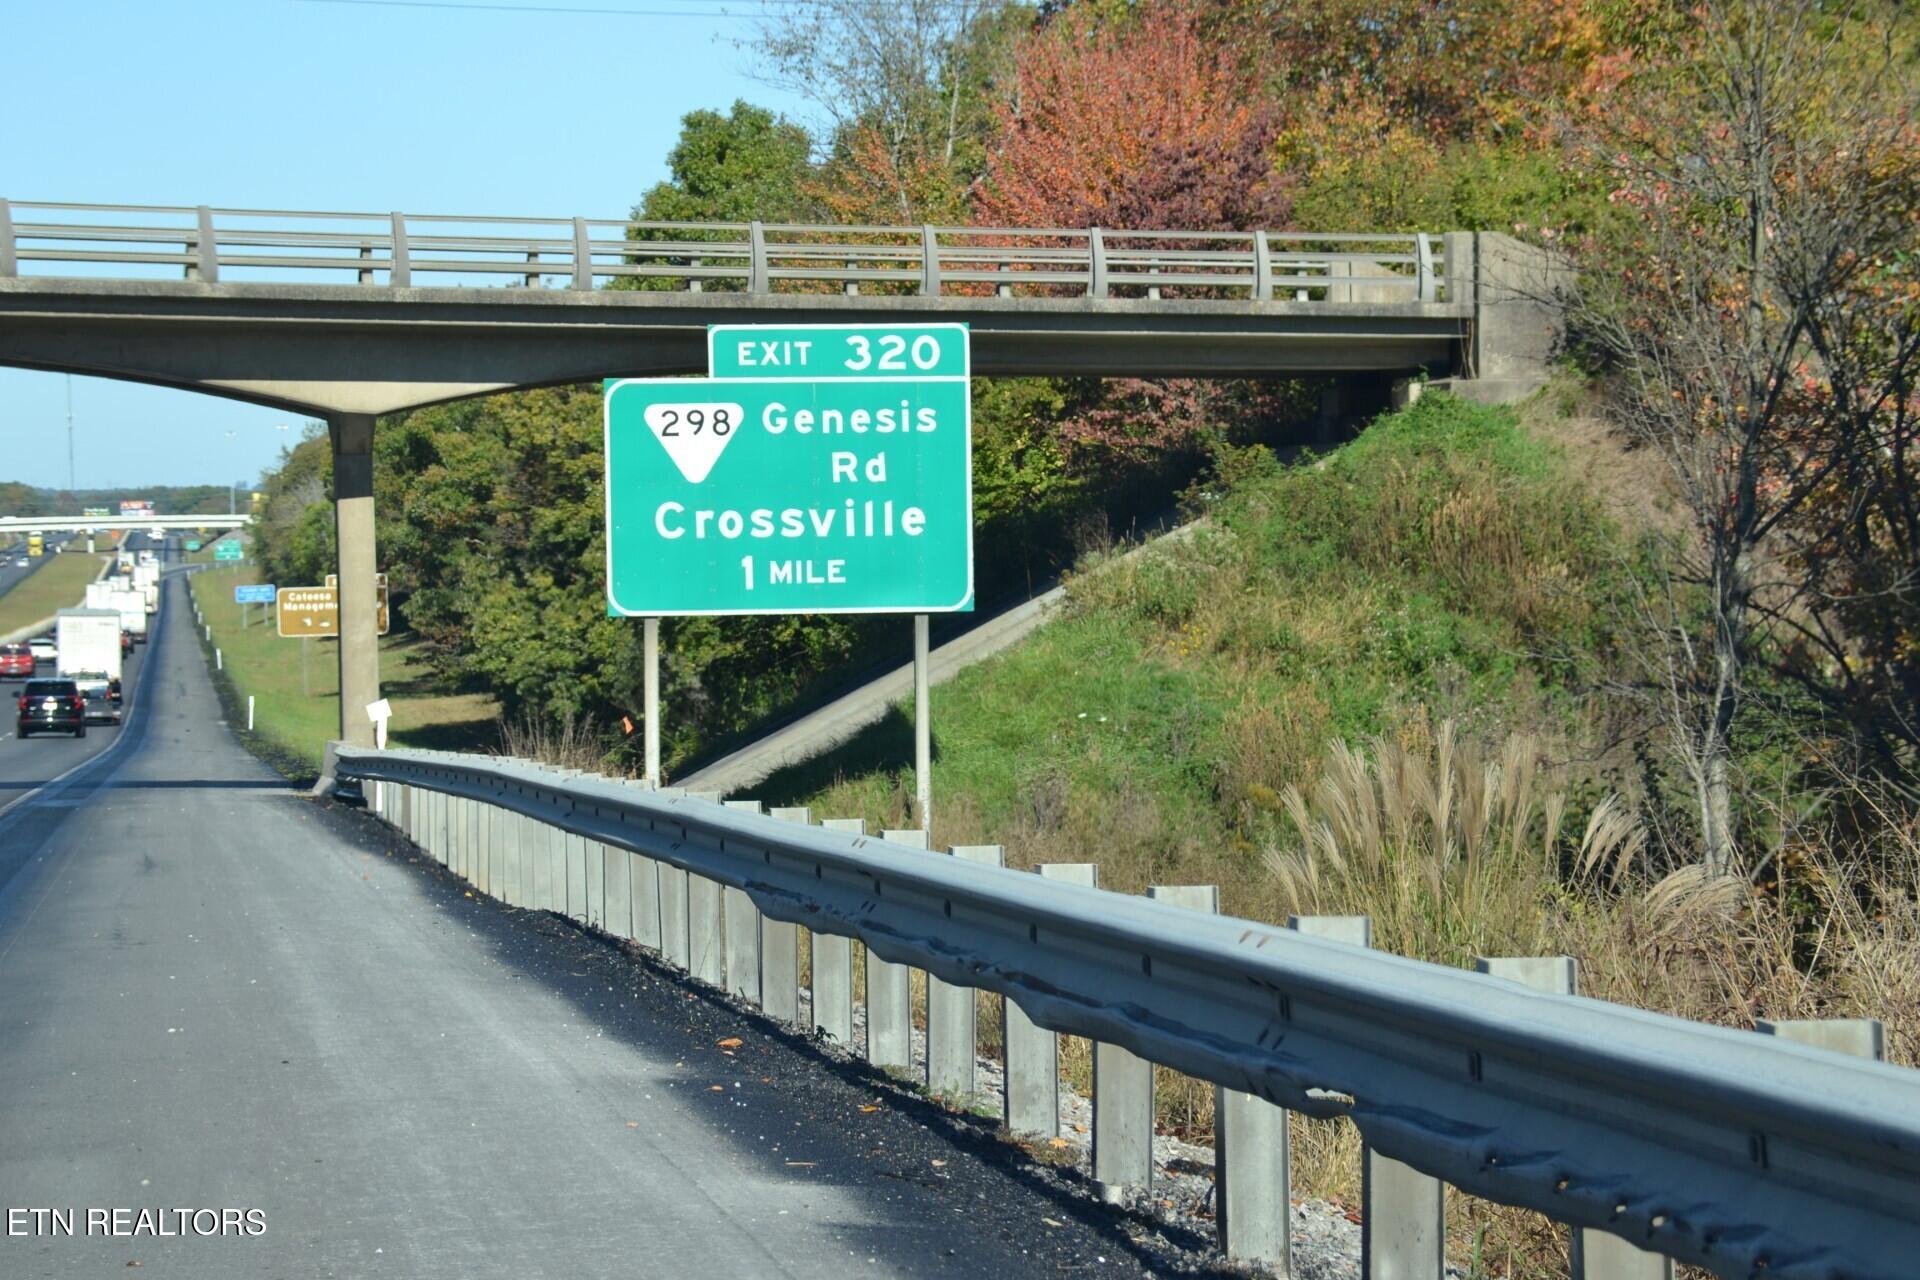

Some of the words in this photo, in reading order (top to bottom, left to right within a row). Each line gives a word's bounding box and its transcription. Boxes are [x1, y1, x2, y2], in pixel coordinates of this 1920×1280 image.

[737, 341, 812, 366] EXIT
[844, 335, 941, 370] 320
[661, 409, 731, 437] 298
[762, 400, 937, 434] Genesis
[832, 451, 887, 483] Rd
[655, 498, 927, 539] Crossville
[741, 555, 754, 590] 1
[770, 560, 847, 585] MILE
